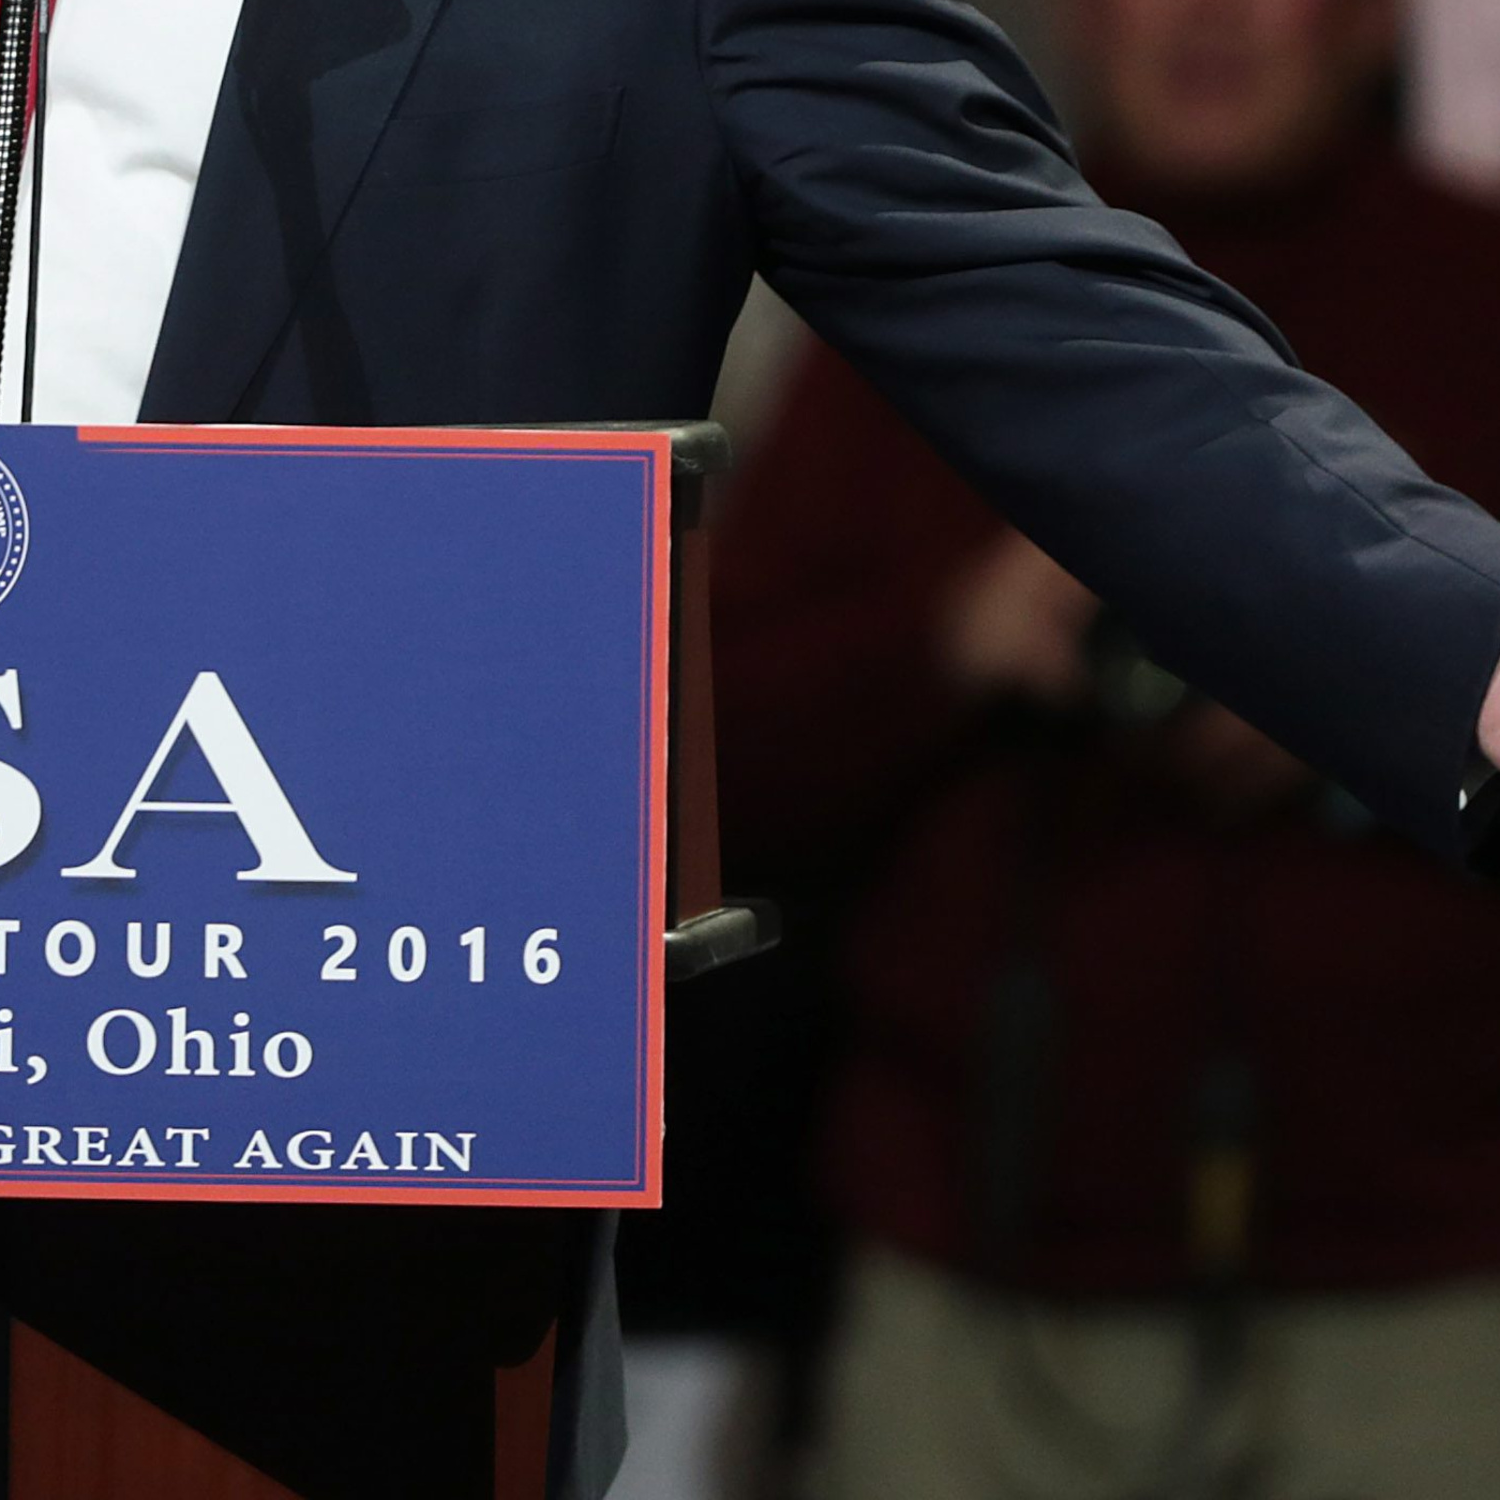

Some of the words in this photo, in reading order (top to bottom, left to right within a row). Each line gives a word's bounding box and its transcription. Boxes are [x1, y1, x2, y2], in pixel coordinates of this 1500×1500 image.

[320, 924, 562, 985] 2016
[86, 1007, 314, 1078] Ohio
[233, 1129, 477, 1172] AGAIN
